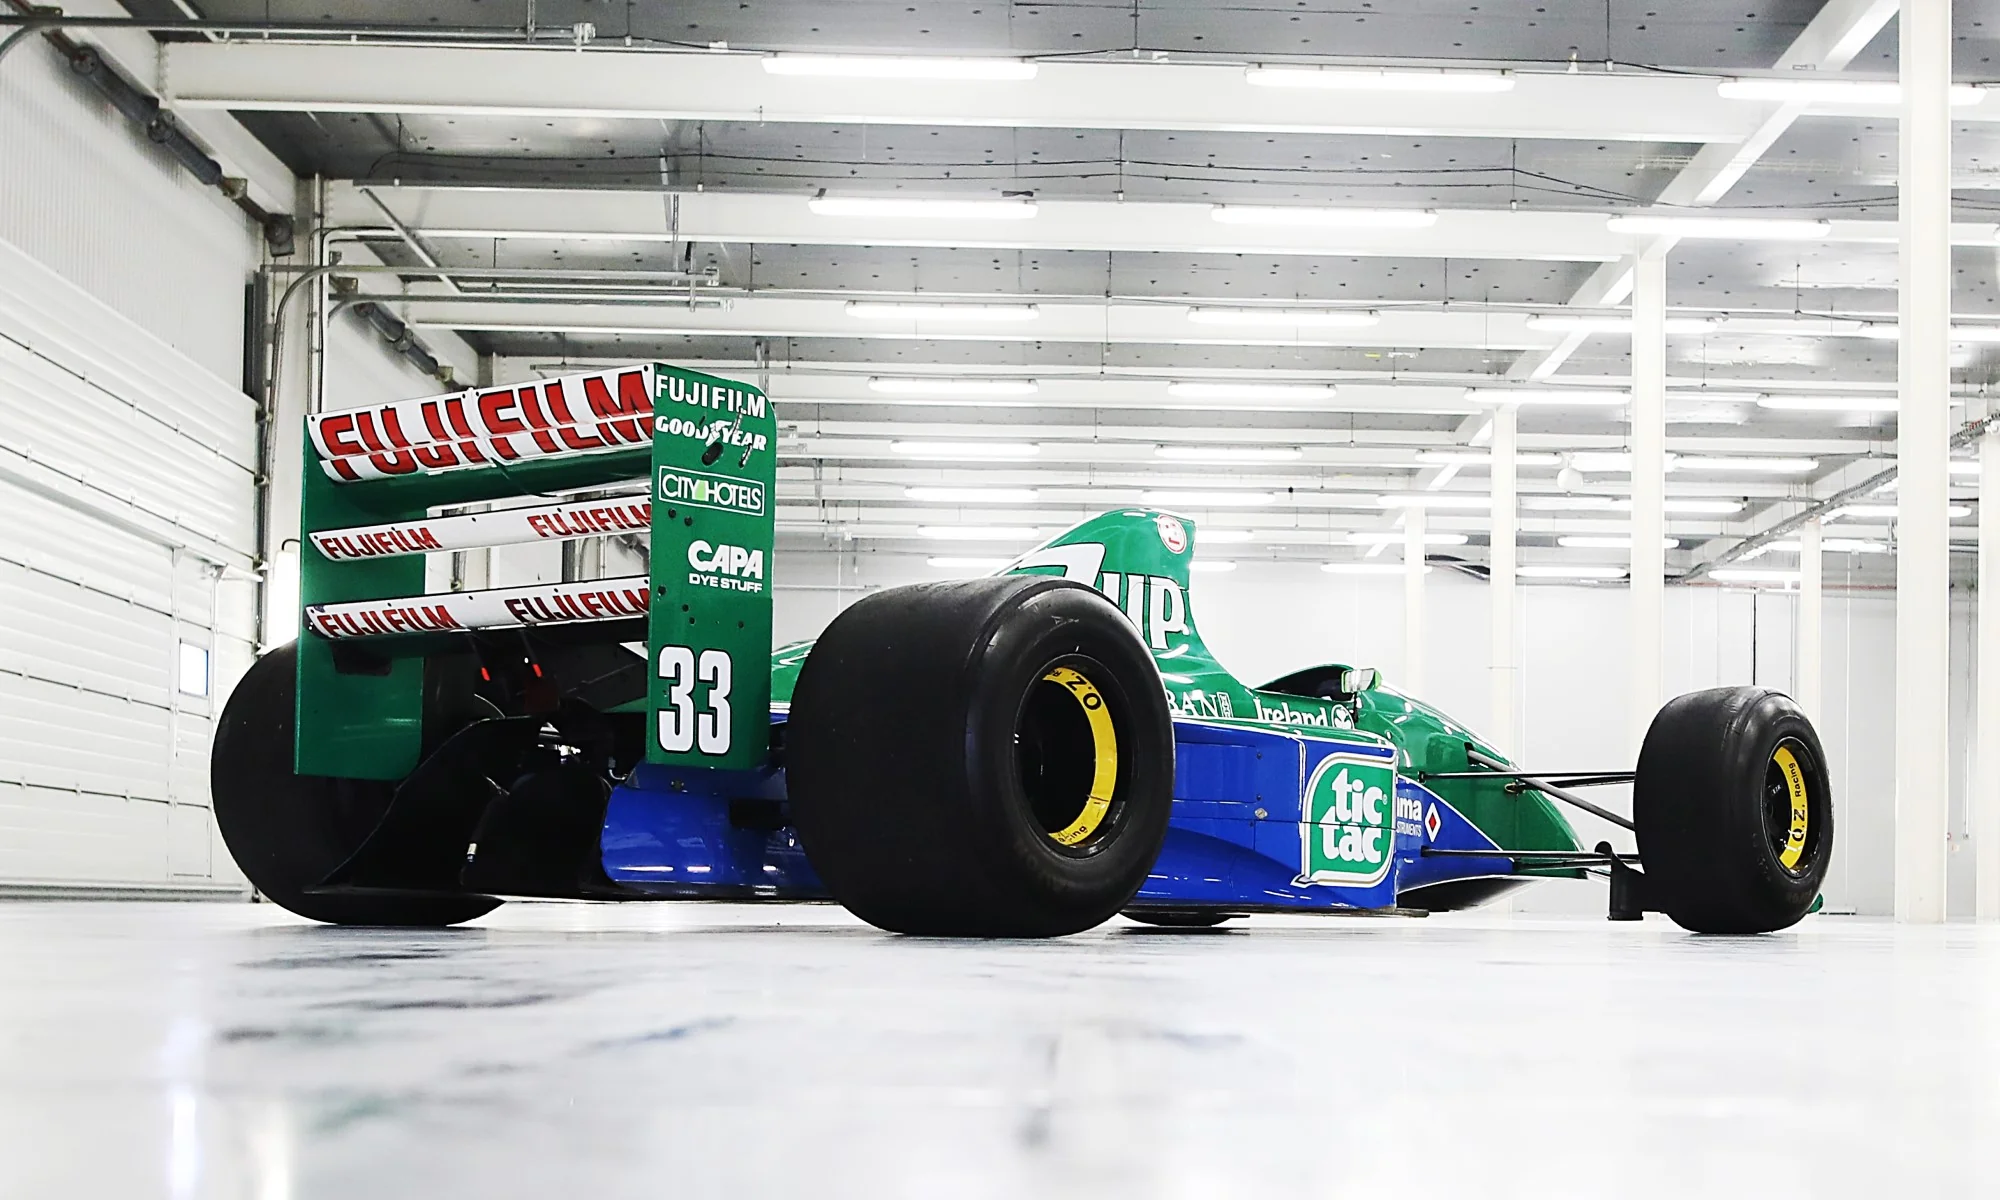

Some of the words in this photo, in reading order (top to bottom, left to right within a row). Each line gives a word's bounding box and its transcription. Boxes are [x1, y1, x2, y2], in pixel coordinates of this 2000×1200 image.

[655, 374, 766, 418] FUJIFILM
[319, 370, 653, 480] FUJIFILM
[655, 415, 767, 451] GOODYEAR
[662, 474, 699, 500] CITY
[704, 480, 762, 510] HOTELS
[319, 527, 443, 559] FUJIFILM
[688, 540, 763, 579] CAPA
[689, 572, 719, 587] DYE
[720, 577, 763, 593] STUFF
[317, 605, 463, 638] FUJIFILM
[658, 646, 732, 755] 33
[1253, 696, 1329, 727] Ireland
[1788, 762, 1802, 797] Racing
[1318, 806, 1382, 864] tac
